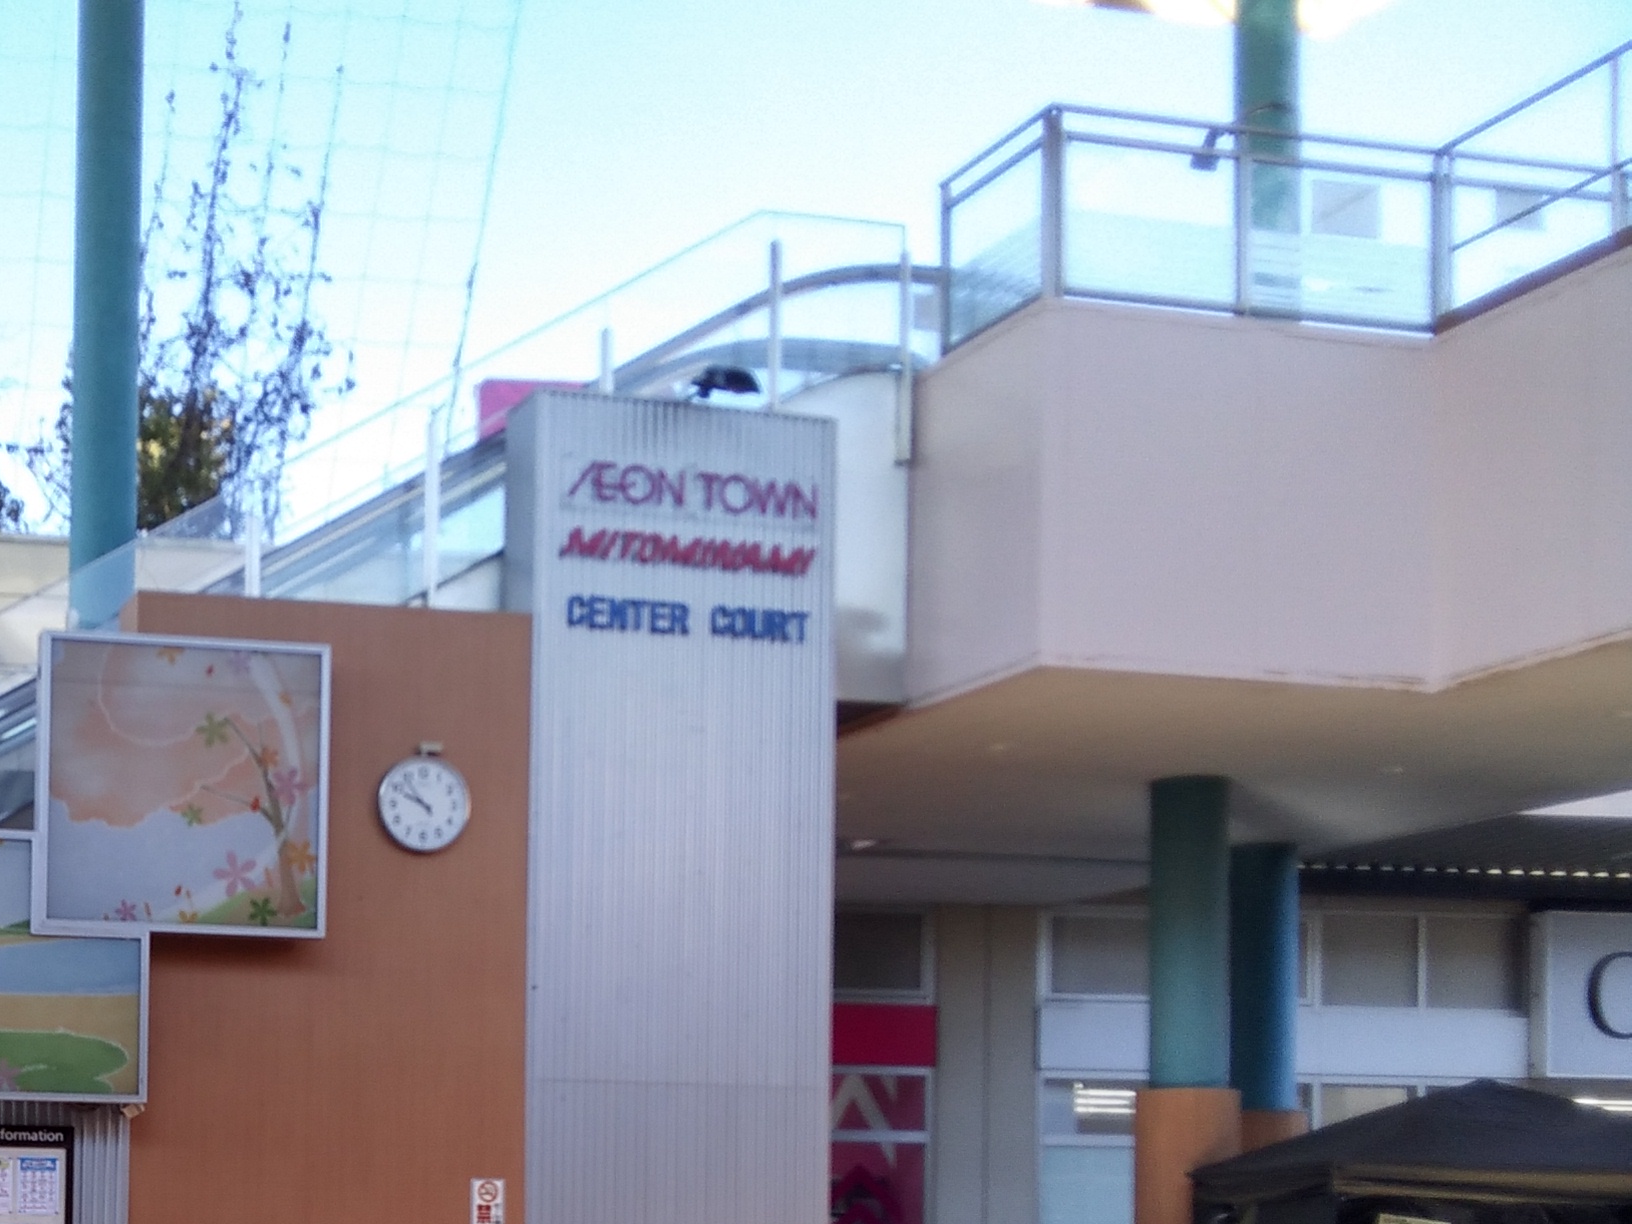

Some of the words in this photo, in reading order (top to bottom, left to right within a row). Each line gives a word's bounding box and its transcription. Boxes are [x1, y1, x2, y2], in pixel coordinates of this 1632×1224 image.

[696, 471, 819, 520] TOWN
[567, 594, 690, 637] CENTER
[711, 604, 810, 645] COURT
